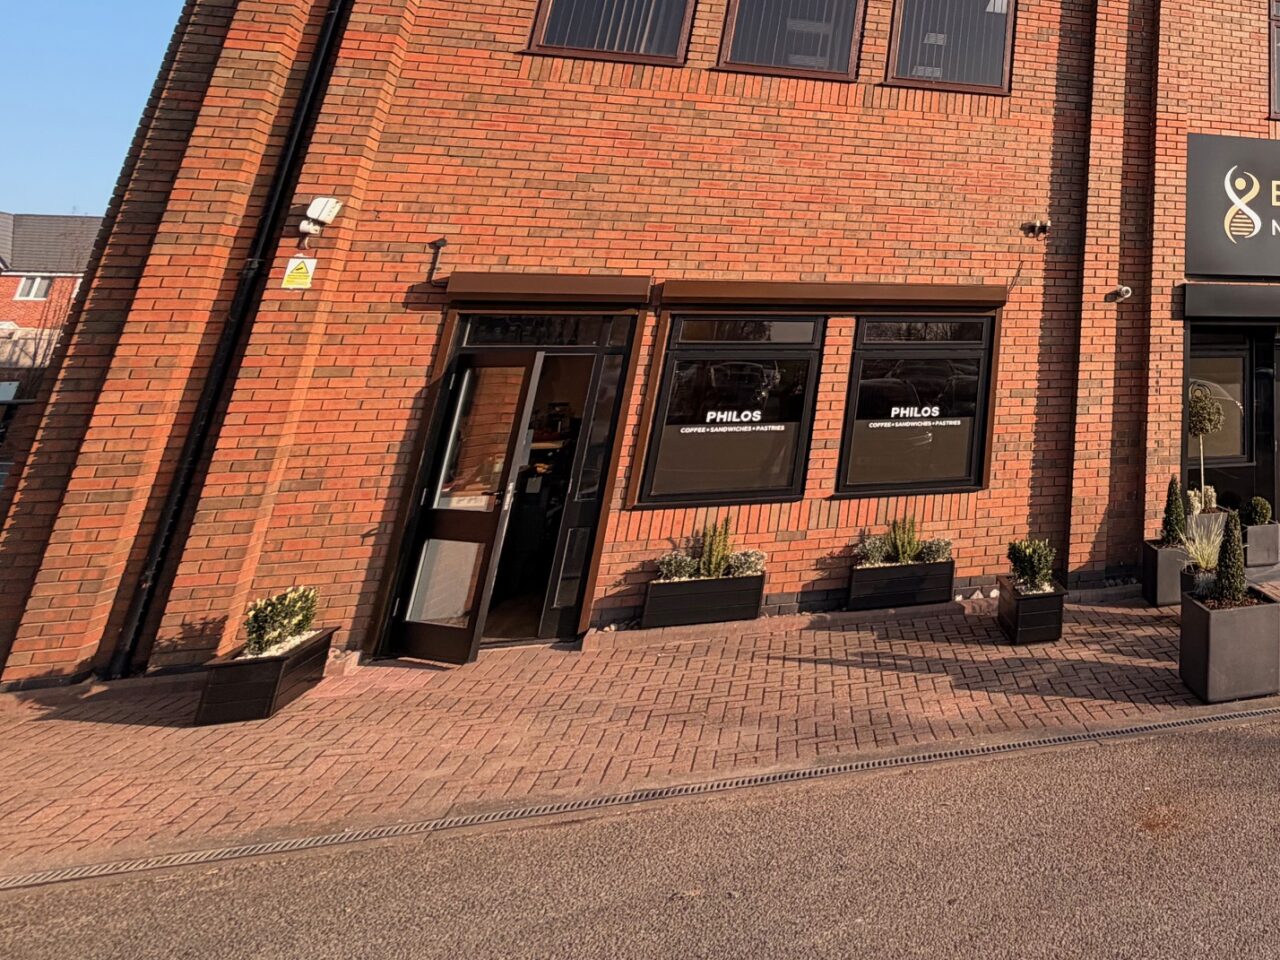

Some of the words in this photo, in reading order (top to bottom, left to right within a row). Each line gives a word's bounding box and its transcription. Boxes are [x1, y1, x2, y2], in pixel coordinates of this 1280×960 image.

[705, 410, 762, 423] PHILOS
[890, 406, 940, 418] PHILOS
[680, 426, 706, 434] COFFEE
[709, 425, 752, 433] SANDWICHES
[755, 424, 785, 432] PASTRIES
[868, 421, 892, 429] COFFEE
